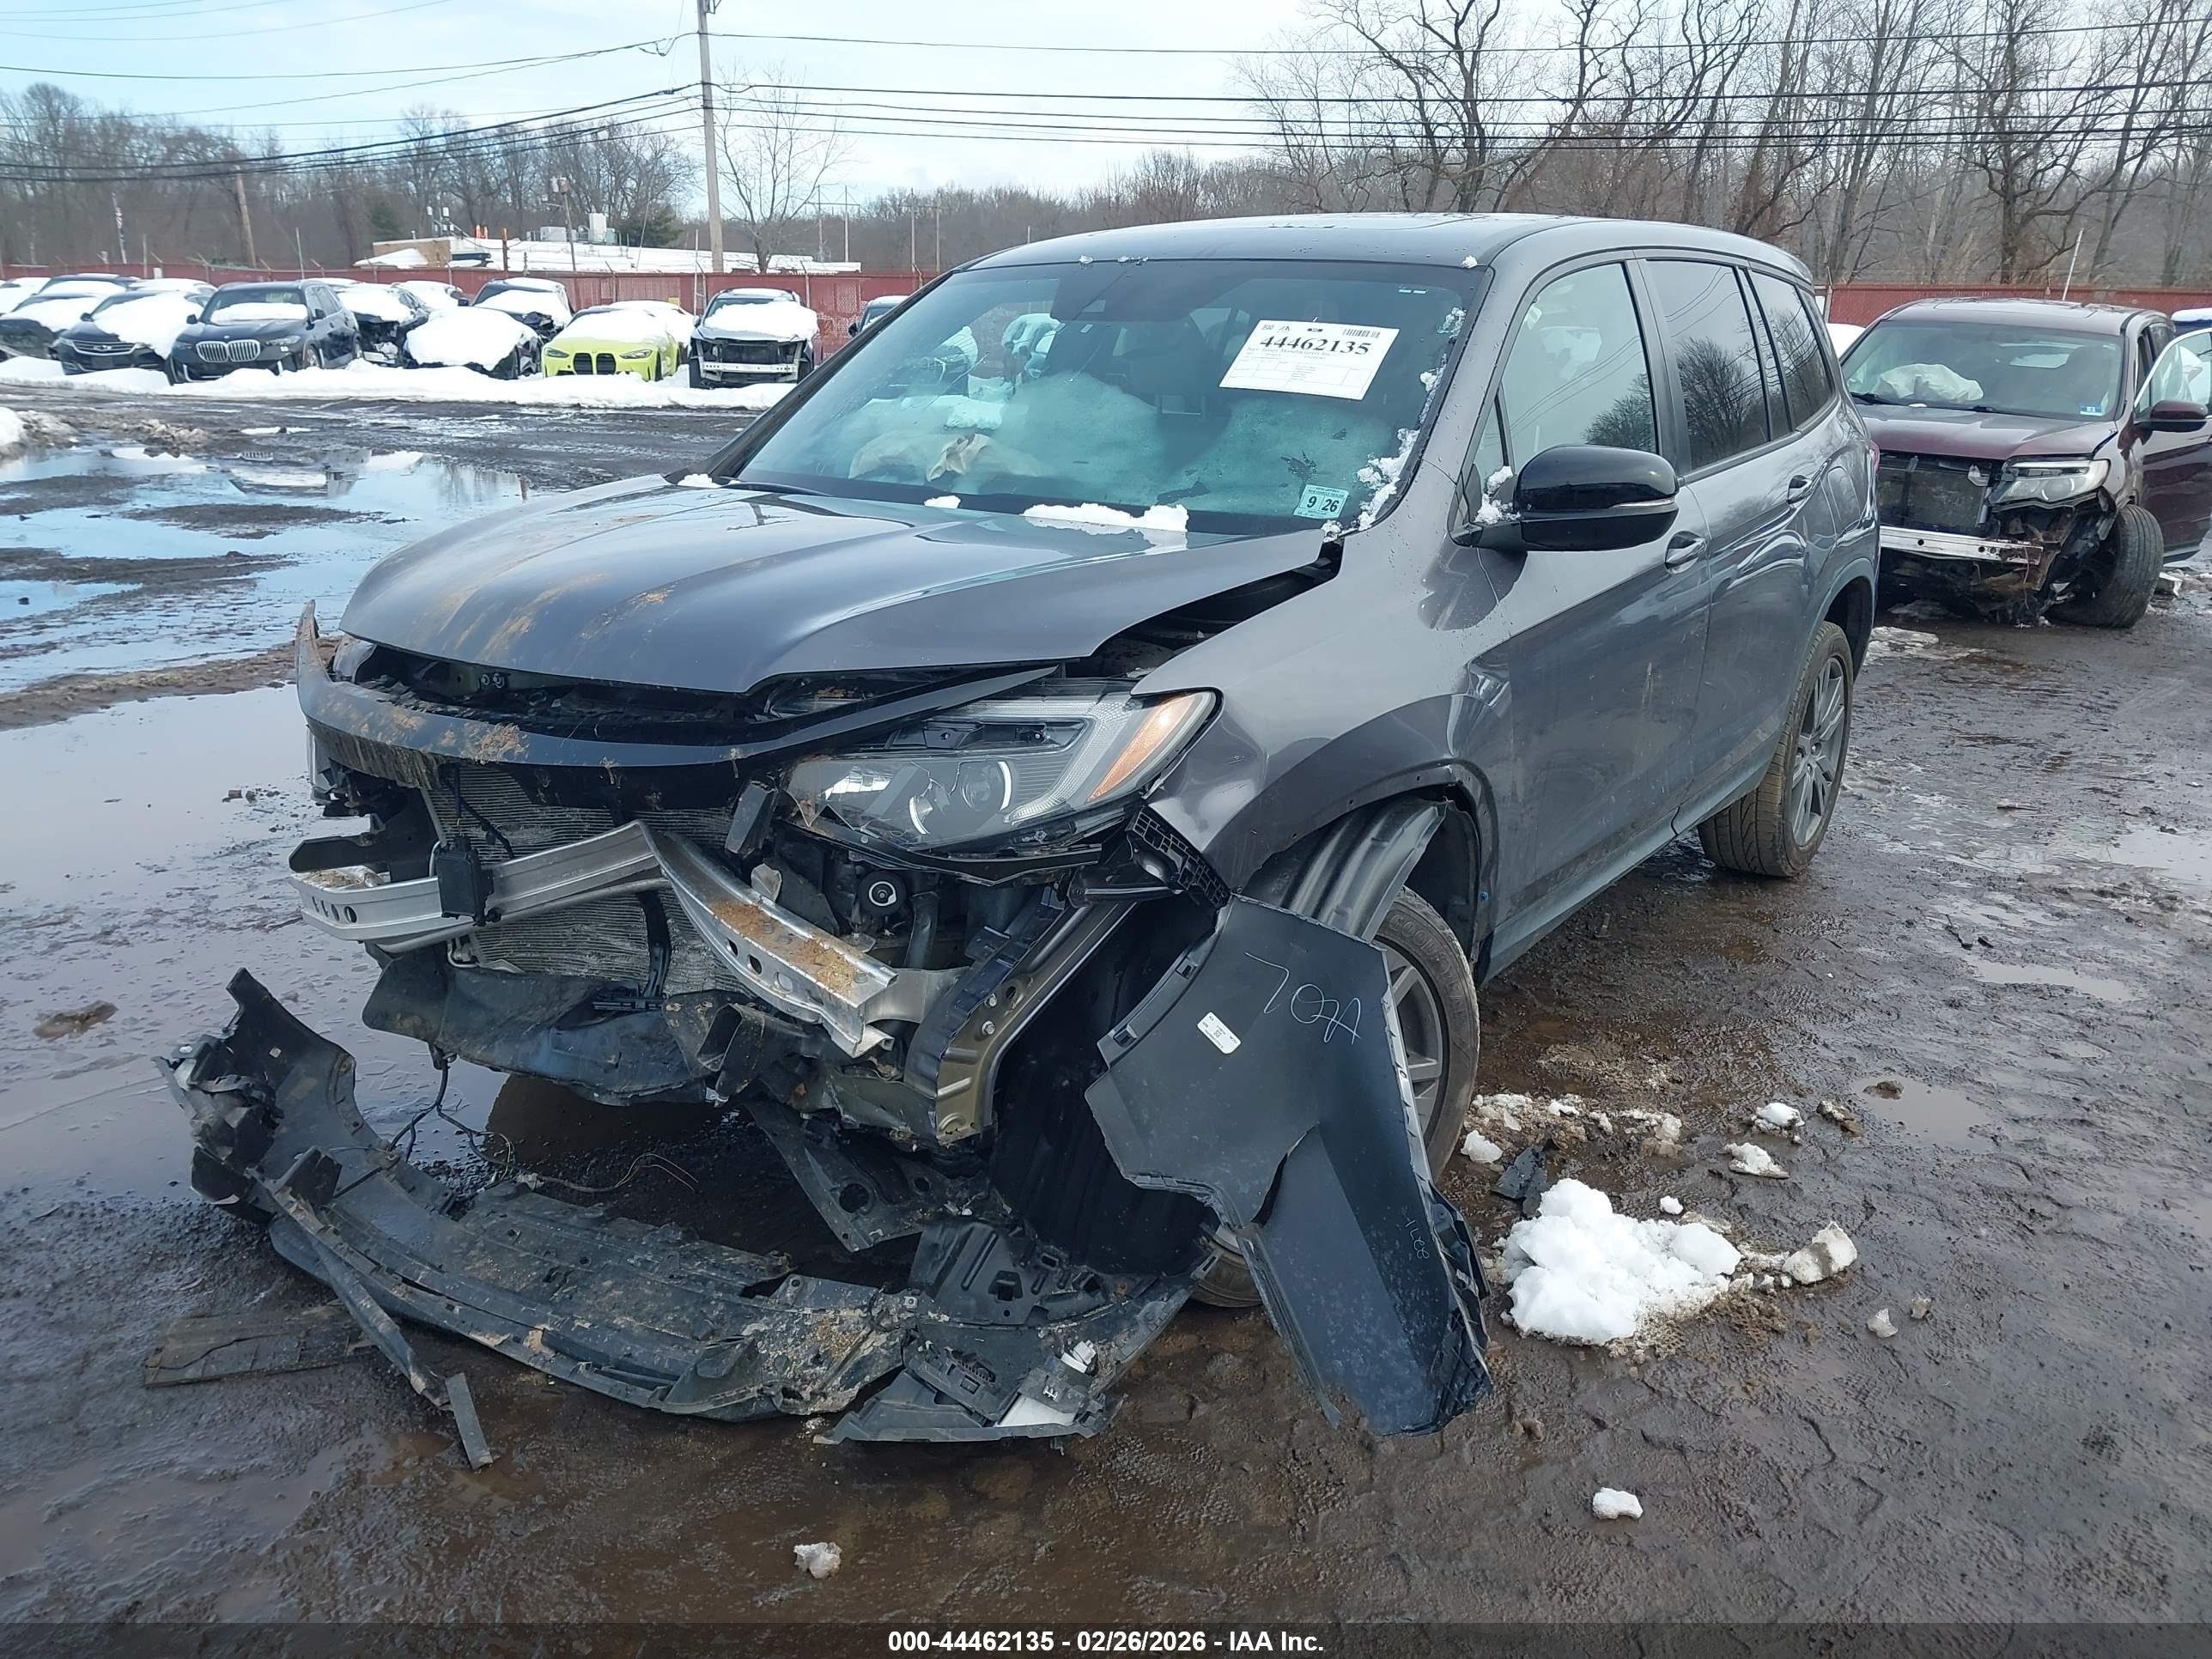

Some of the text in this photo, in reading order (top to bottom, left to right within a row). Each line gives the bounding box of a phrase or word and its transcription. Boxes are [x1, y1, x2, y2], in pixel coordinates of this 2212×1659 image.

[1260, 335, 1372, 356] 44462135
[1306, 495, 1340, 513] 9 26
